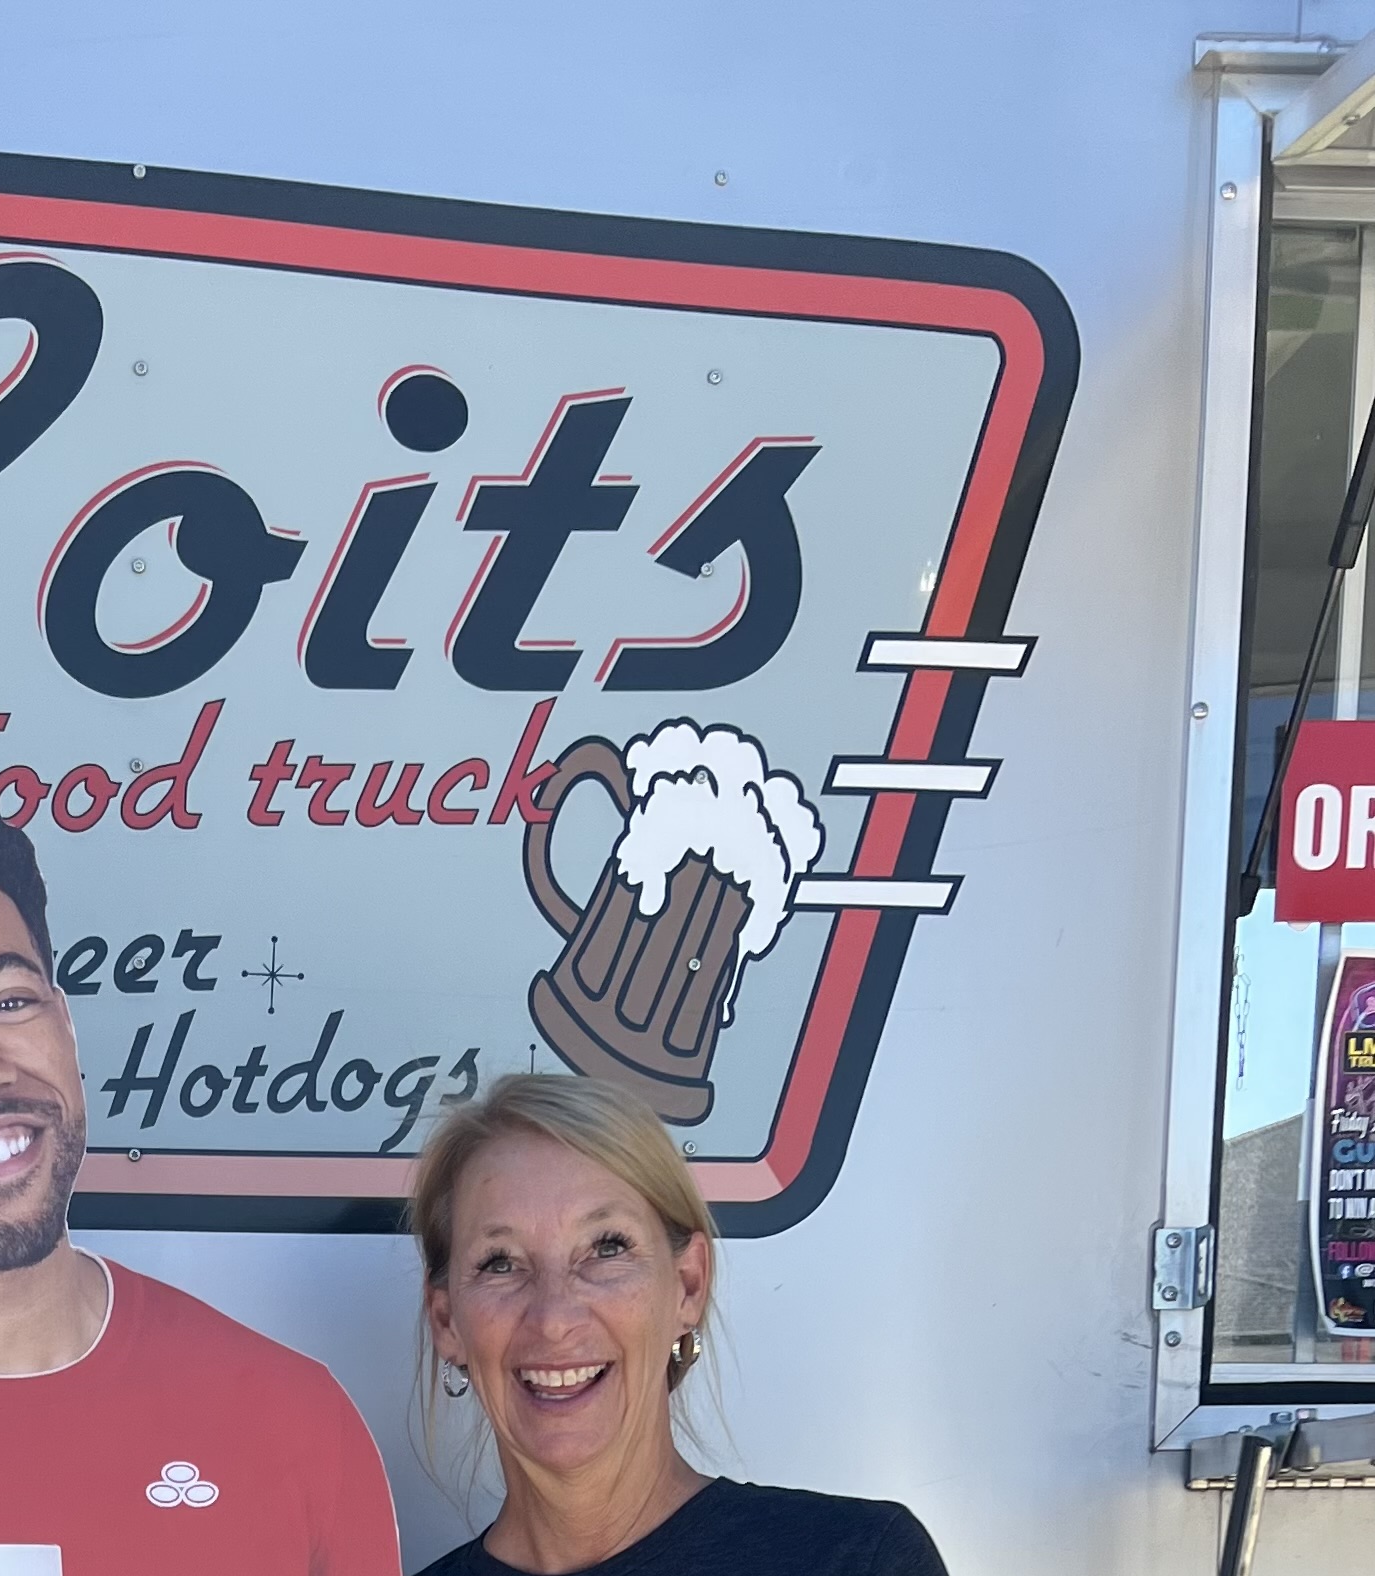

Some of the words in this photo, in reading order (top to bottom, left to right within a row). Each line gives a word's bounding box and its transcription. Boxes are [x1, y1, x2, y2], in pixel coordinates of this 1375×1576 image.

[247, 696, 561, 827] truck
[52, 928, 222, 995] eer
[100, 1009, 481, 1153] Hotdogs
